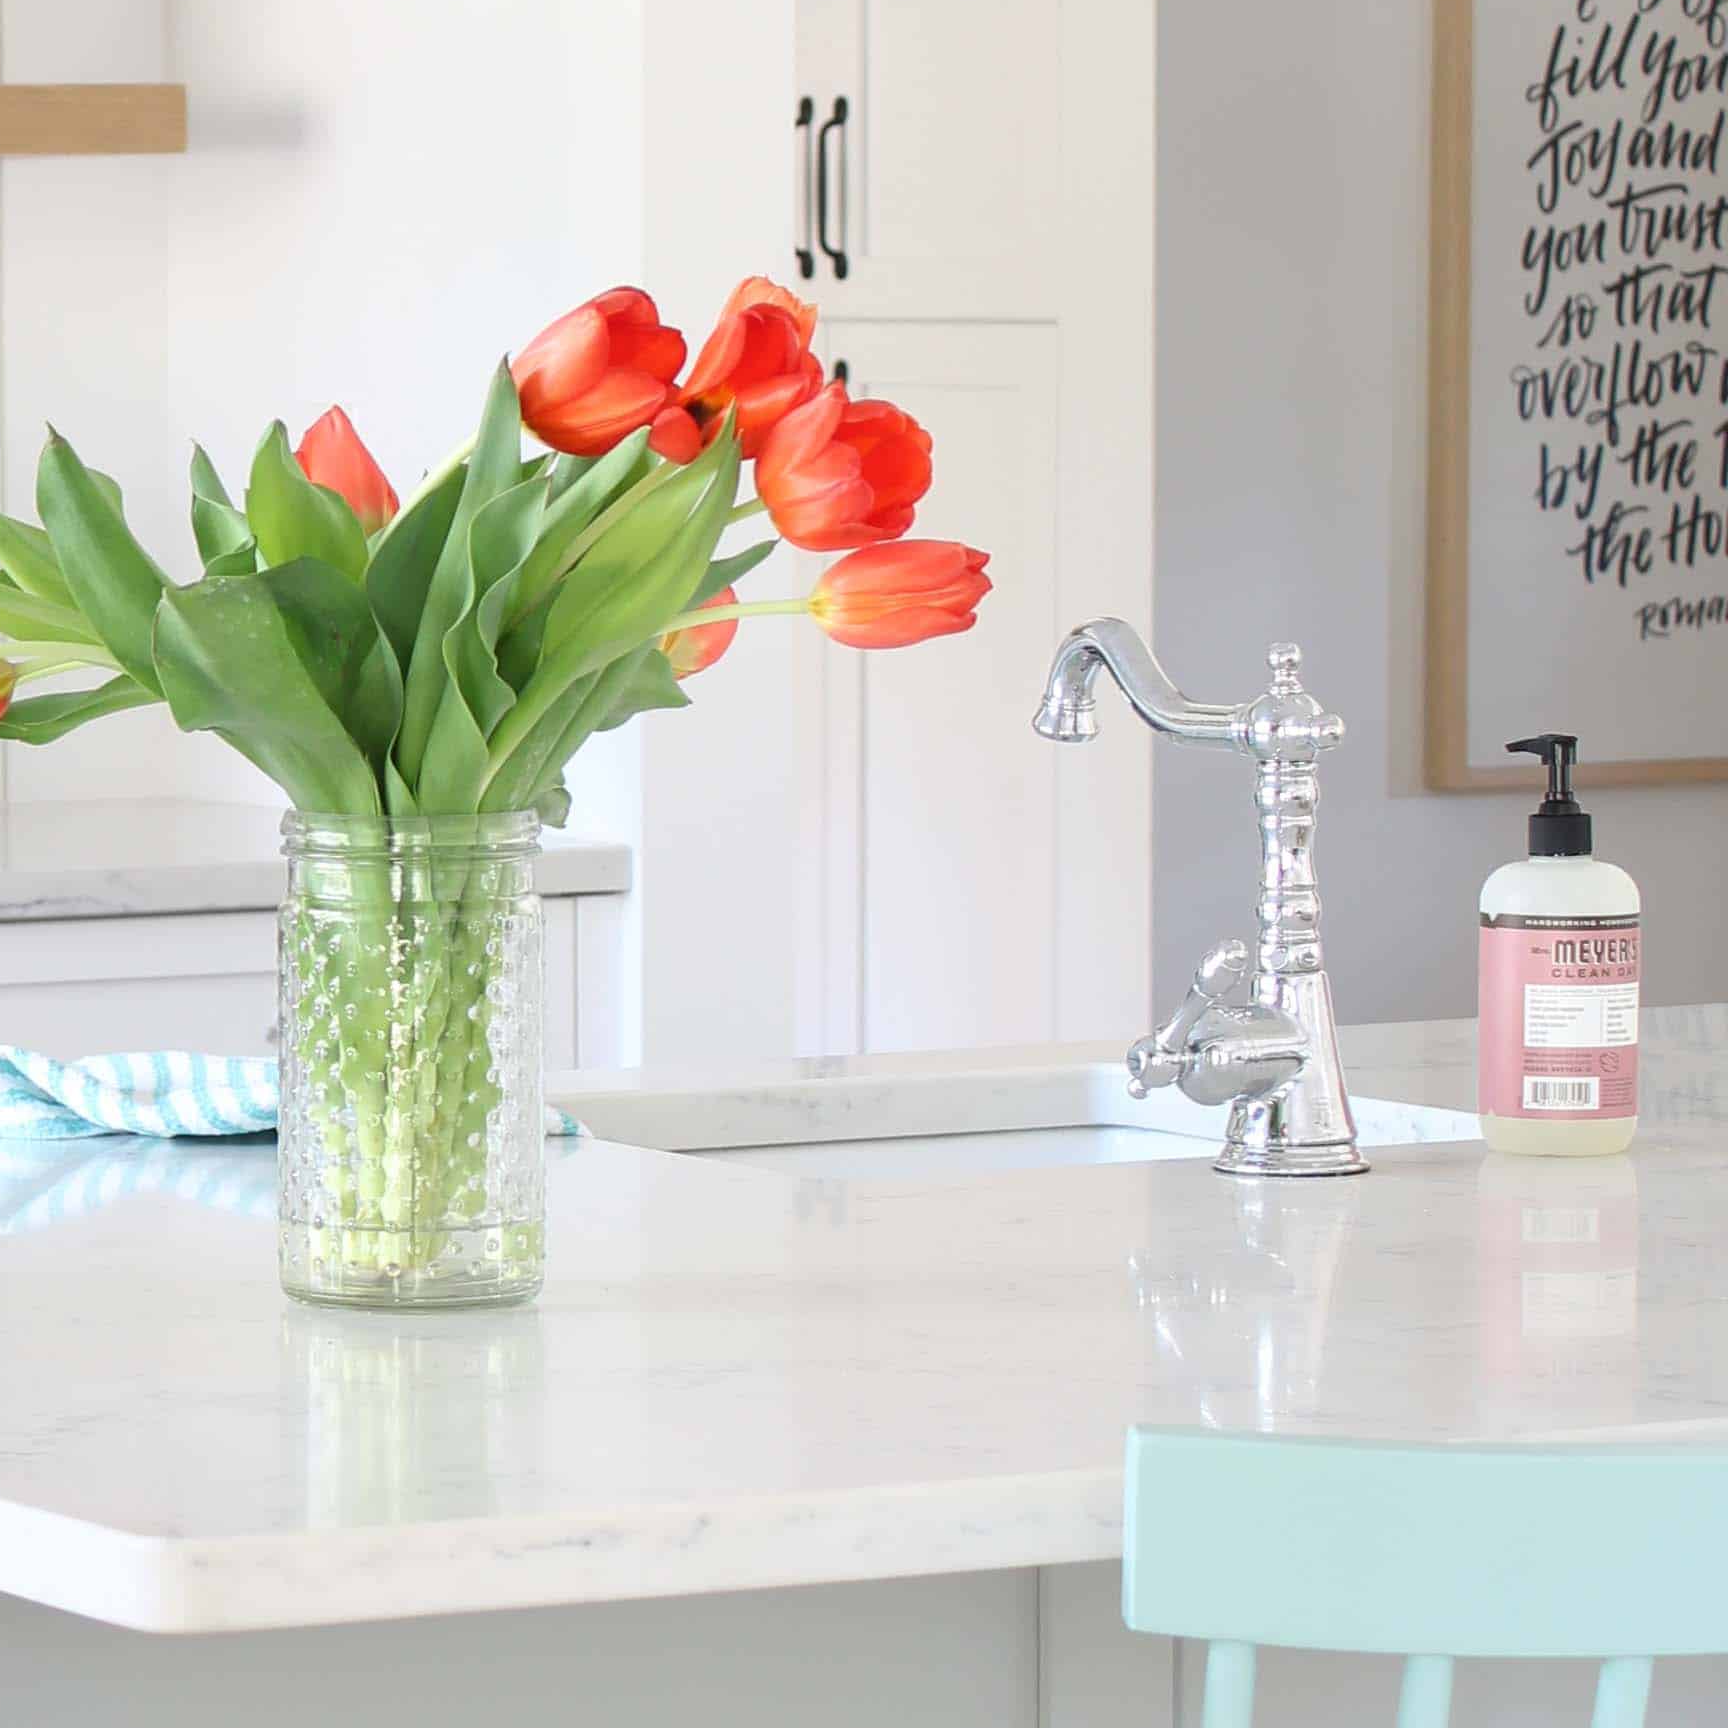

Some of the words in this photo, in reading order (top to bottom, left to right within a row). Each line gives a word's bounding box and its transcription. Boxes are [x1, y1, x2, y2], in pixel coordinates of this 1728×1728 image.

[1526, 12, 1641, 133] fill
[1527, 119, 1623, 215] Joy
[1627, 109, 1726, 174] and
[1522, 219, 1607, 316] you
[1607, 181, 1728, 258] trust
[1536, 293, 1599, 349] so
[1603, 263, 1728, 334] that
[1510, 339, 1718, 448] overflow
[1534, 442, 1605, 520] by
[1617, 419, 1698, 493] the
[1565, 501, 1654, 588] the
[1661, 493, 1728, 567] Ho
[1634, 595, 1728, 641] Roma
[1551, 967, 1611, 979] CLEAN
